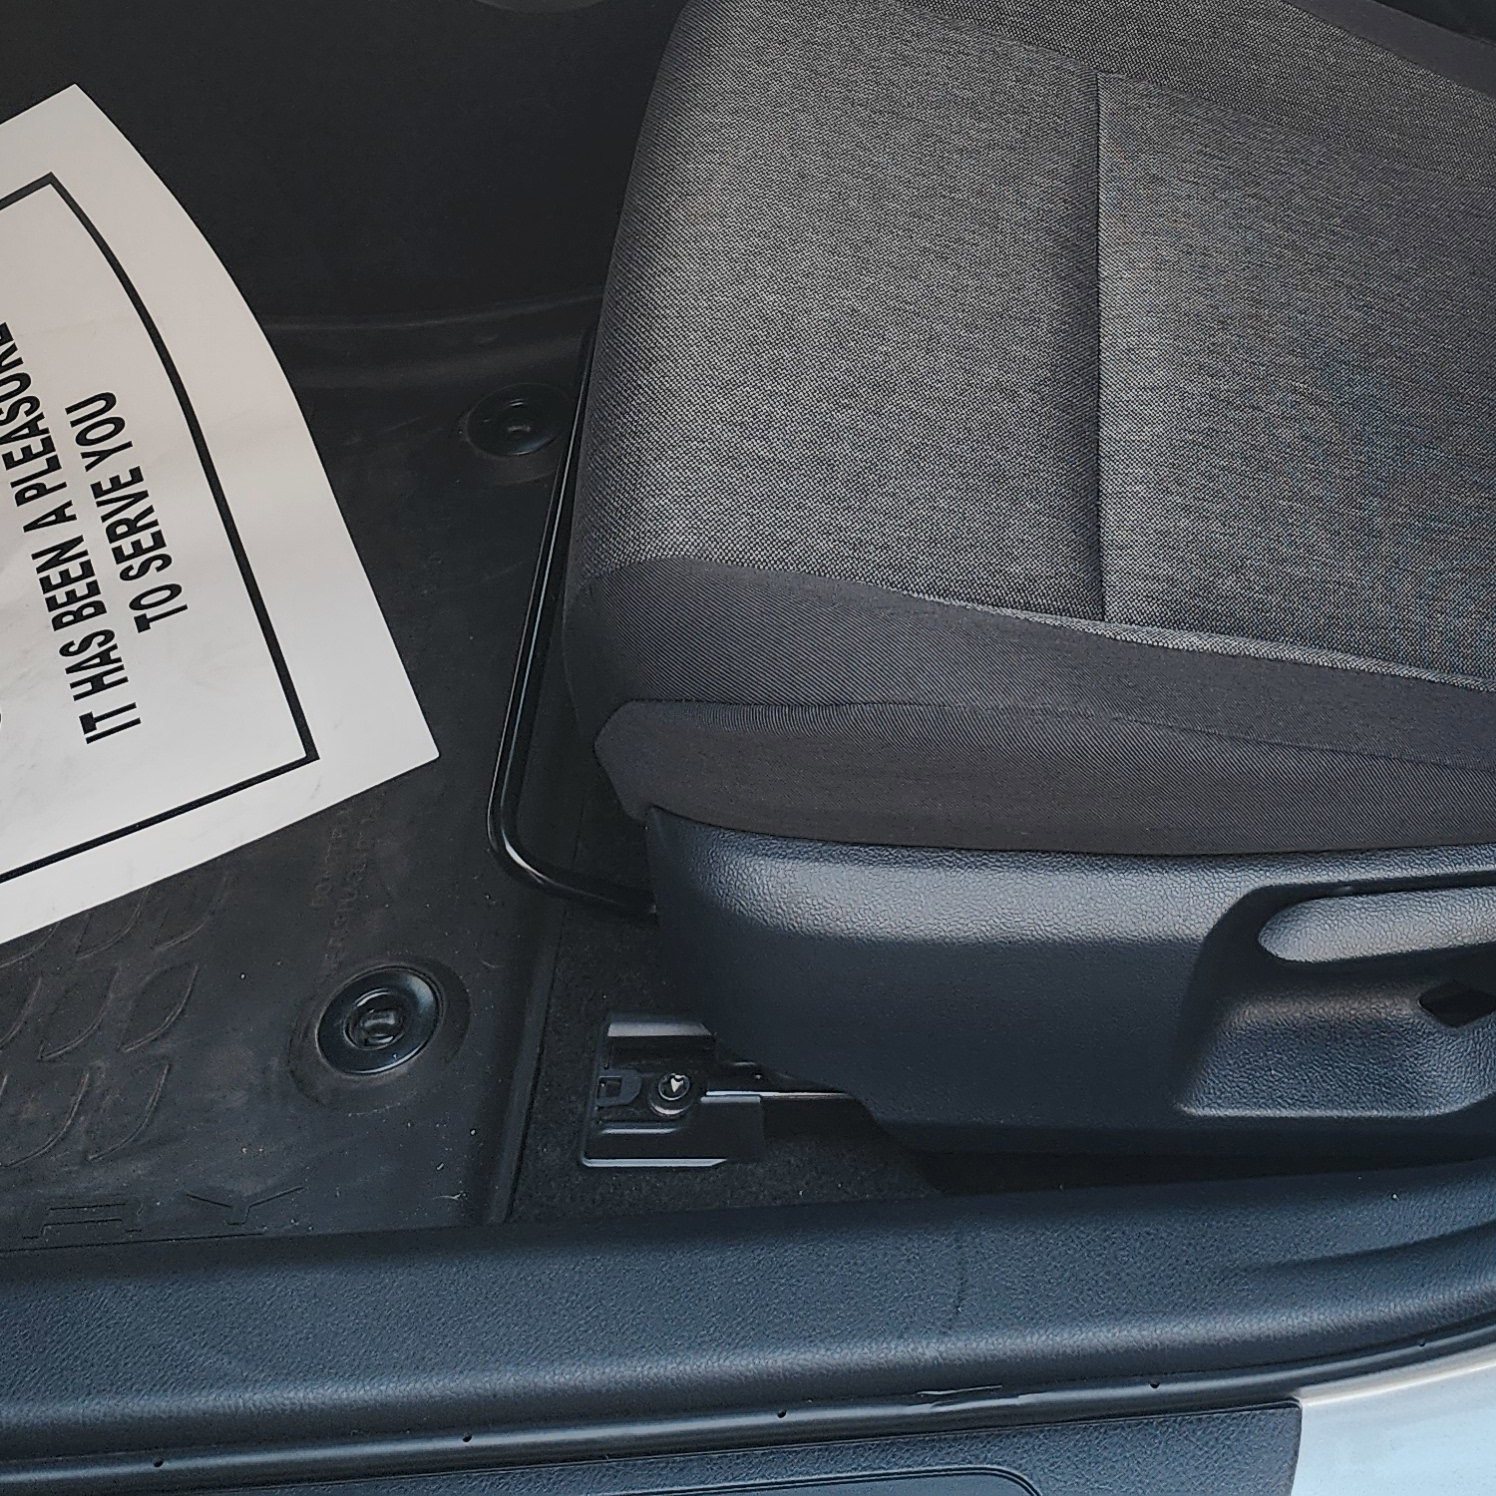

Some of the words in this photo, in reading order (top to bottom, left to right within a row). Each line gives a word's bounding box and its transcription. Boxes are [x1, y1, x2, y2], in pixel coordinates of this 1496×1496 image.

[0, 322, 68, 507] PLEASU
[65, 392, 132, 472] YOU
[23, 500, 77, 533] A
[91, 466, 173, 582] SERVE
[32, 535, 107, 632] BEEN
[129, 584, 187, 633] TO
[58, 630, 128, 701] HAS
[79, 702, 142, 744] IT
